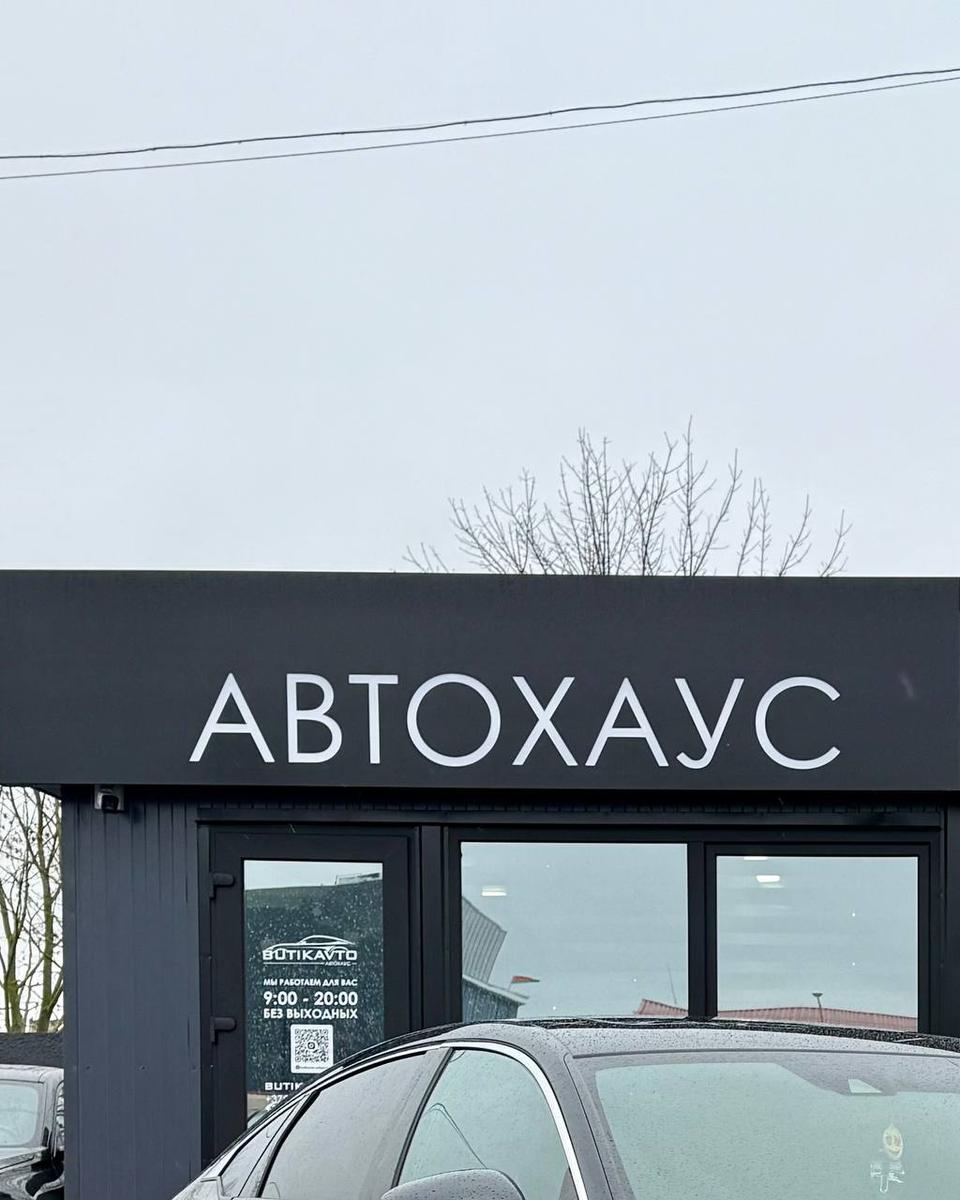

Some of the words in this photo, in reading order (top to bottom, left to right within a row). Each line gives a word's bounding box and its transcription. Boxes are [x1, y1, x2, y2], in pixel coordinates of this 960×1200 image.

[189, 672, 842, 770] АВТОХАУС
[262, 949, 357, 961] BUTIKAVTO
[263, 991, 298, 1006] 9:00
[314, 991, 358, 1006] 20:00
[263, 1008, 284, 1019] БЕЗ
[286, 1008, 358, 1020] ВЫХОДНЫХ
[265, 1082, 303, 1091] BUTIK
